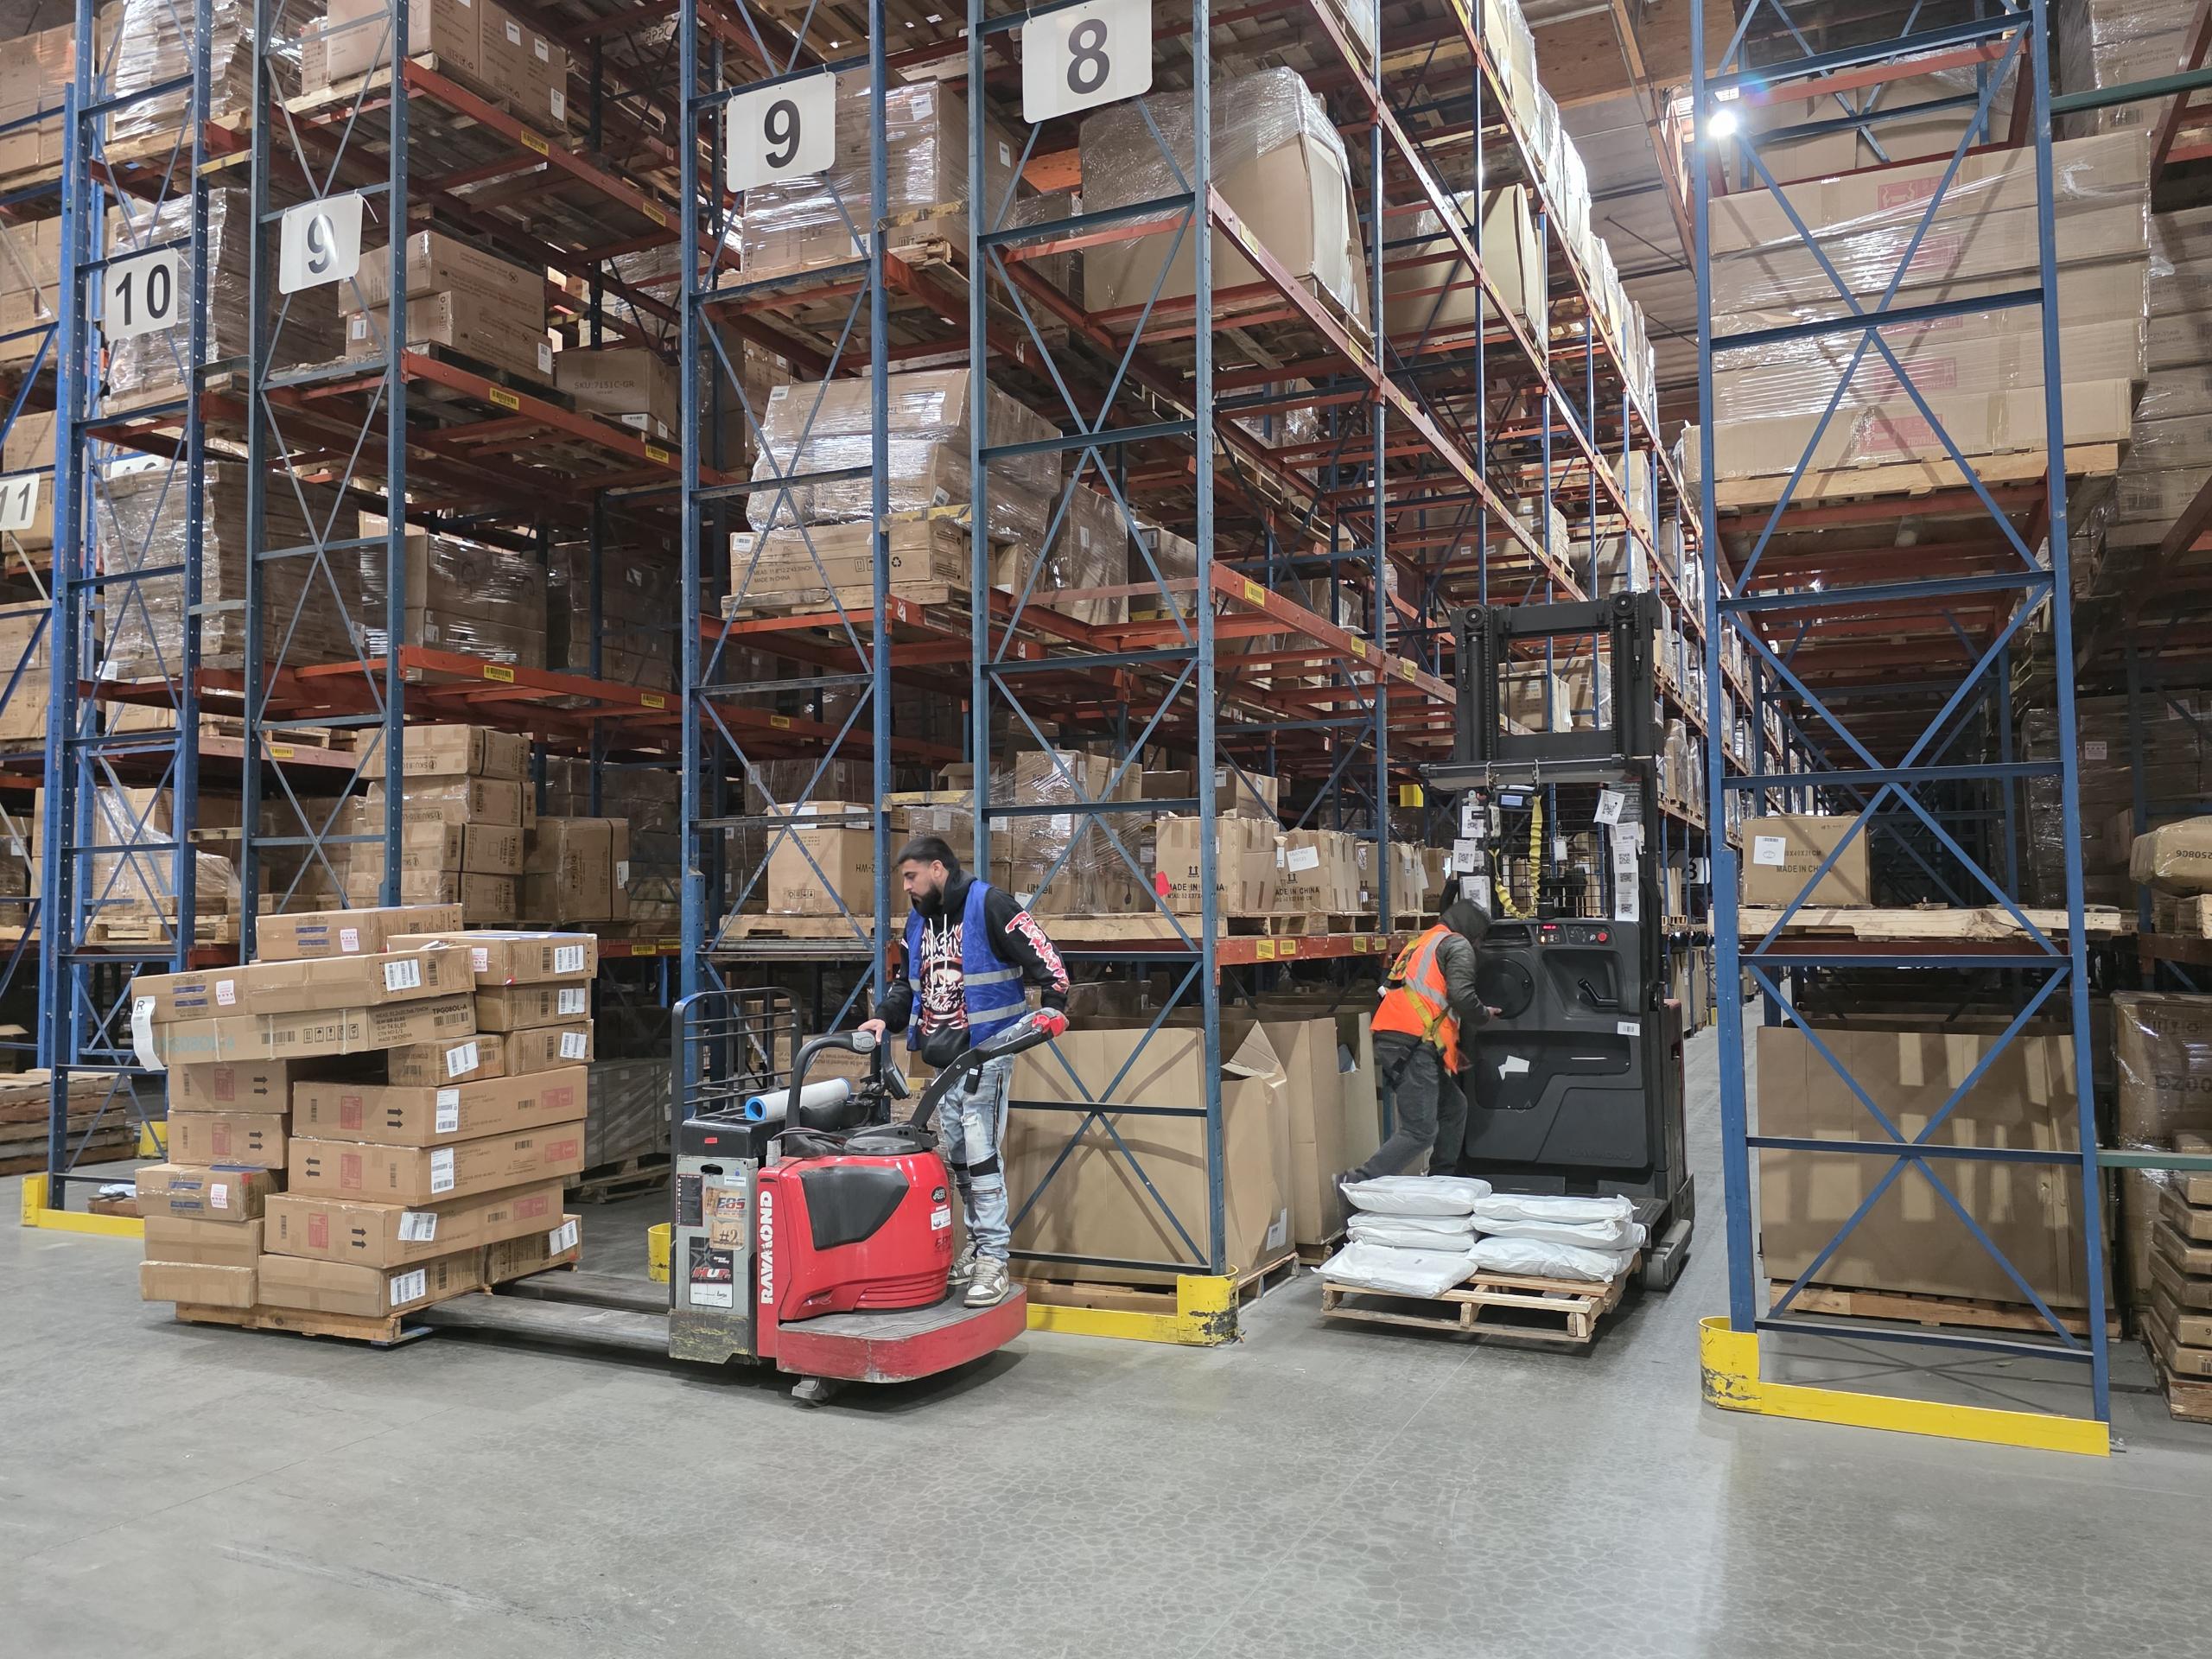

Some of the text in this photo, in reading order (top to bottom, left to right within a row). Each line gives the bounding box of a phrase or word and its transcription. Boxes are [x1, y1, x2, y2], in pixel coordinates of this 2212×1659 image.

[1067, 18, 1110, 94] 8
[764, 99, 801, 169] 9
[308, 214, 335, 274] 9
[115, 264, 171, 326] 10
[0, 483, 31, 522] 11
[1299, 886, 1319, 894] CHINA
[136, 1000, 145, 1012] R
